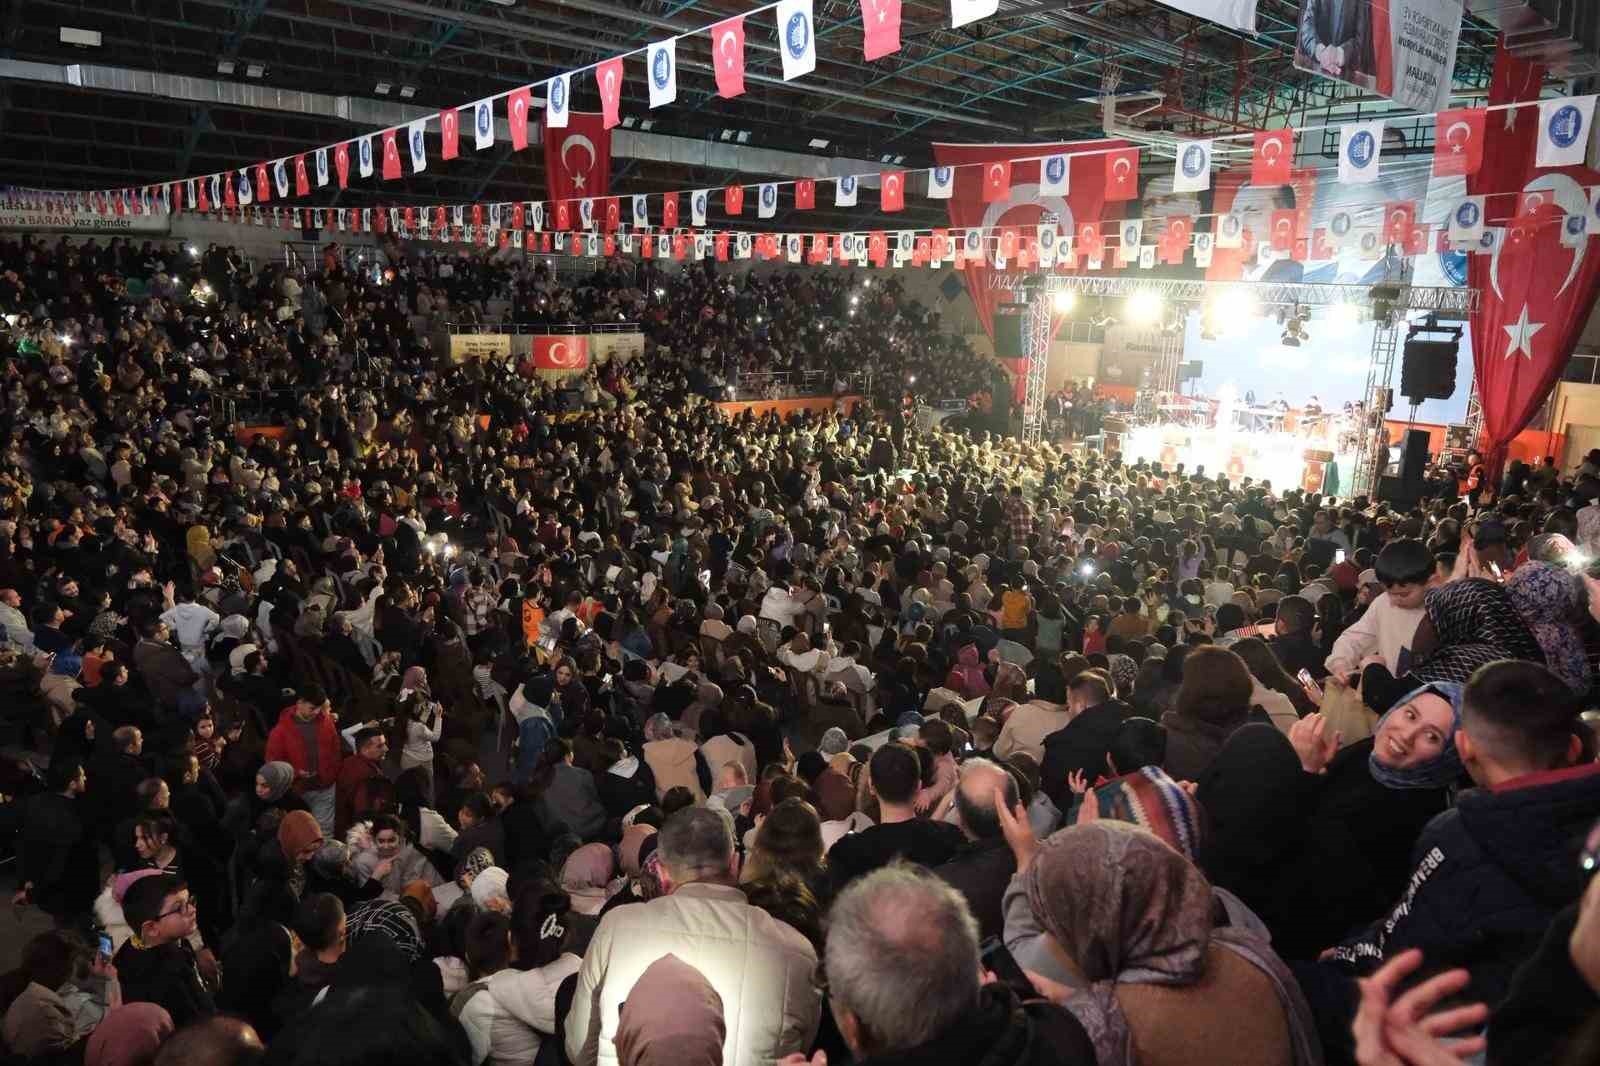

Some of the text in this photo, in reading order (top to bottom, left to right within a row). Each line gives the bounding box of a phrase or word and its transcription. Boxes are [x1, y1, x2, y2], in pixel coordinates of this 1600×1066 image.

[29, 216, 70, 225] BARAN
[73, 218, 91, 228] yaz
[94, 217, 131, 229] gönder
